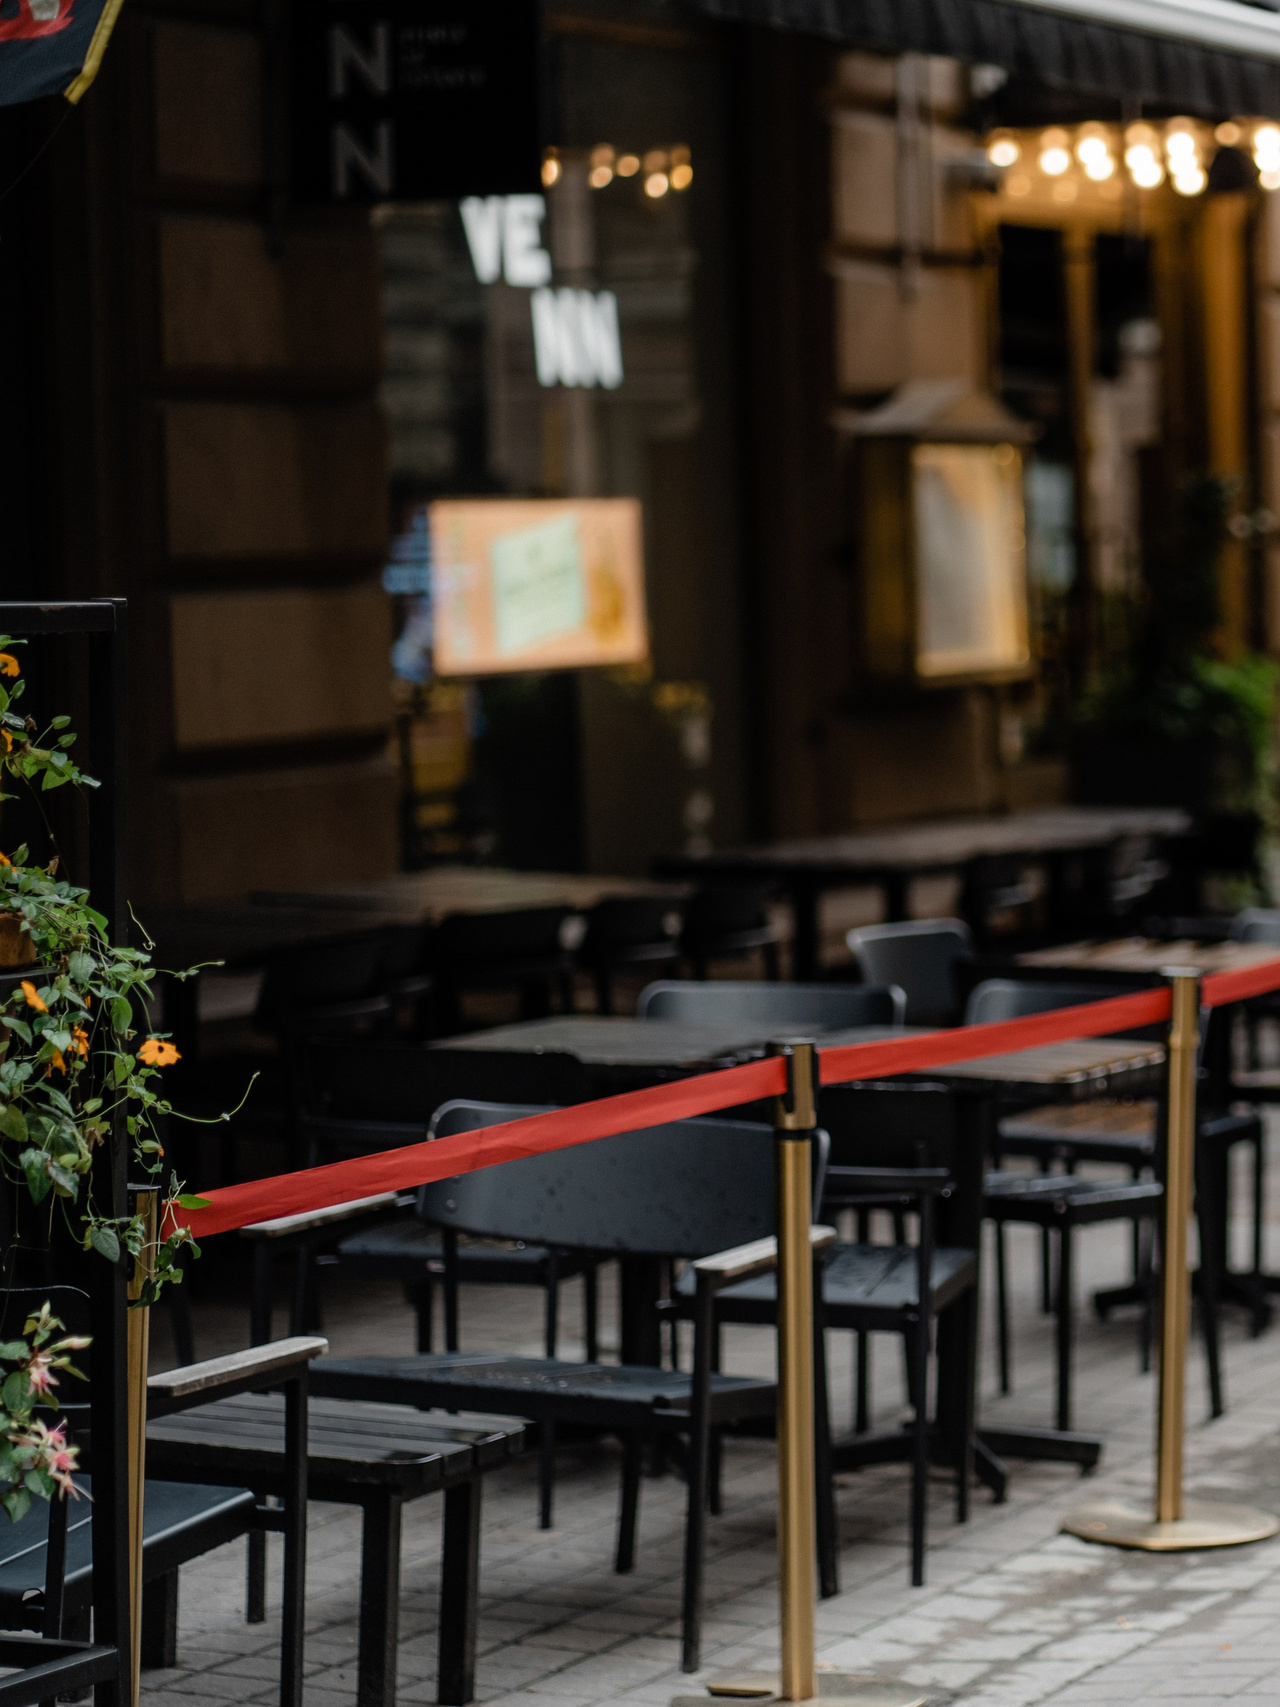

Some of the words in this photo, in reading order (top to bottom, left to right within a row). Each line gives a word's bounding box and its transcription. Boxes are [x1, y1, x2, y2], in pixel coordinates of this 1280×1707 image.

[329, 21, 393, 98] N
[331, 120, 395, 196] N
[460, 195, 551, 287] VE
